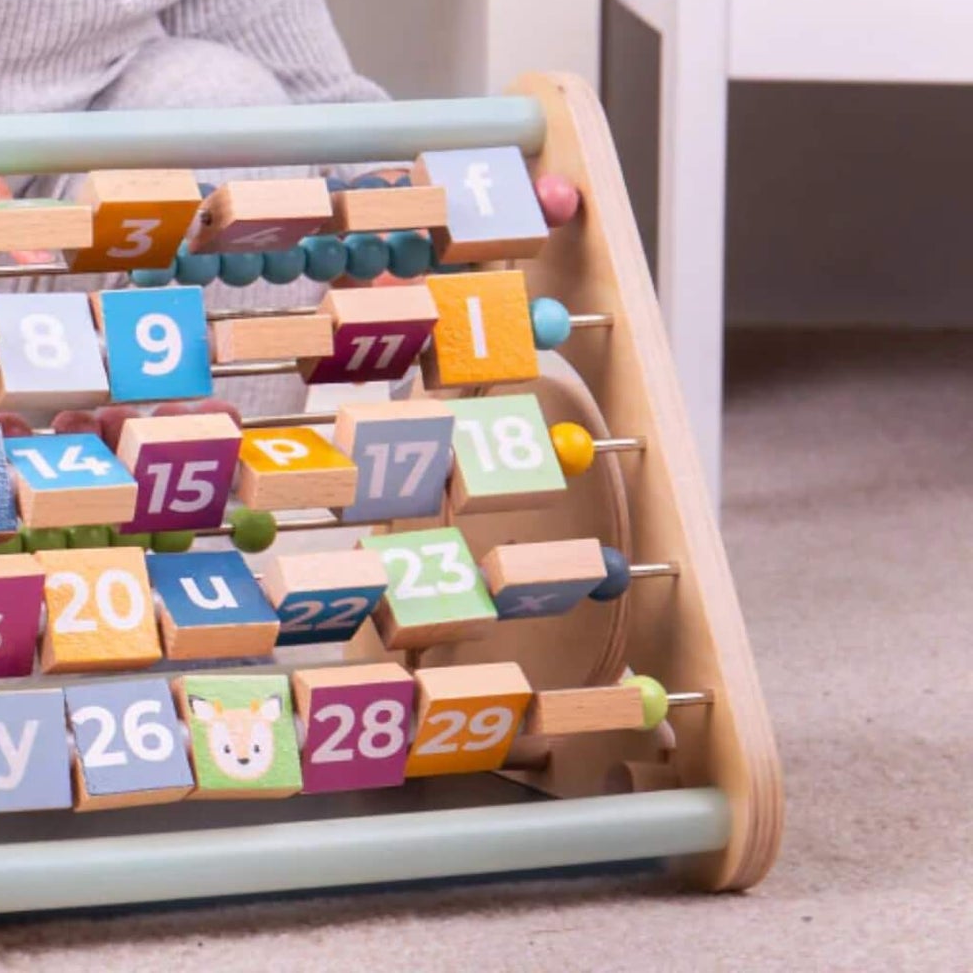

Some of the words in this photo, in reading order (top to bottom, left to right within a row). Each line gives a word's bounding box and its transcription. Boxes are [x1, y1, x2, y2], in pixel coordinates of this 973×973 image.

[465, 163, 493, 216] f
[107, 219, 160, 257] 3
[21, 314, 70, 368] 8
[136, 313, 181, 374] 9
[346, 335, 404, 370] 11
[13, 446, 111, 479] 14
[364, 441, 437, 498] 17
[458, 416, 541, 471] 18
[147, 460, 218, 513] 15
[180, 575, 237, 608] u
[382, 542, 474, 599] 23
[46, 570, 144, 633] 20
[285, 597, 367, 628] 22
[70, 700, 172, 767] 26
[311, 699, 404, 764] 28
[416, 707, 512, 755] 29
